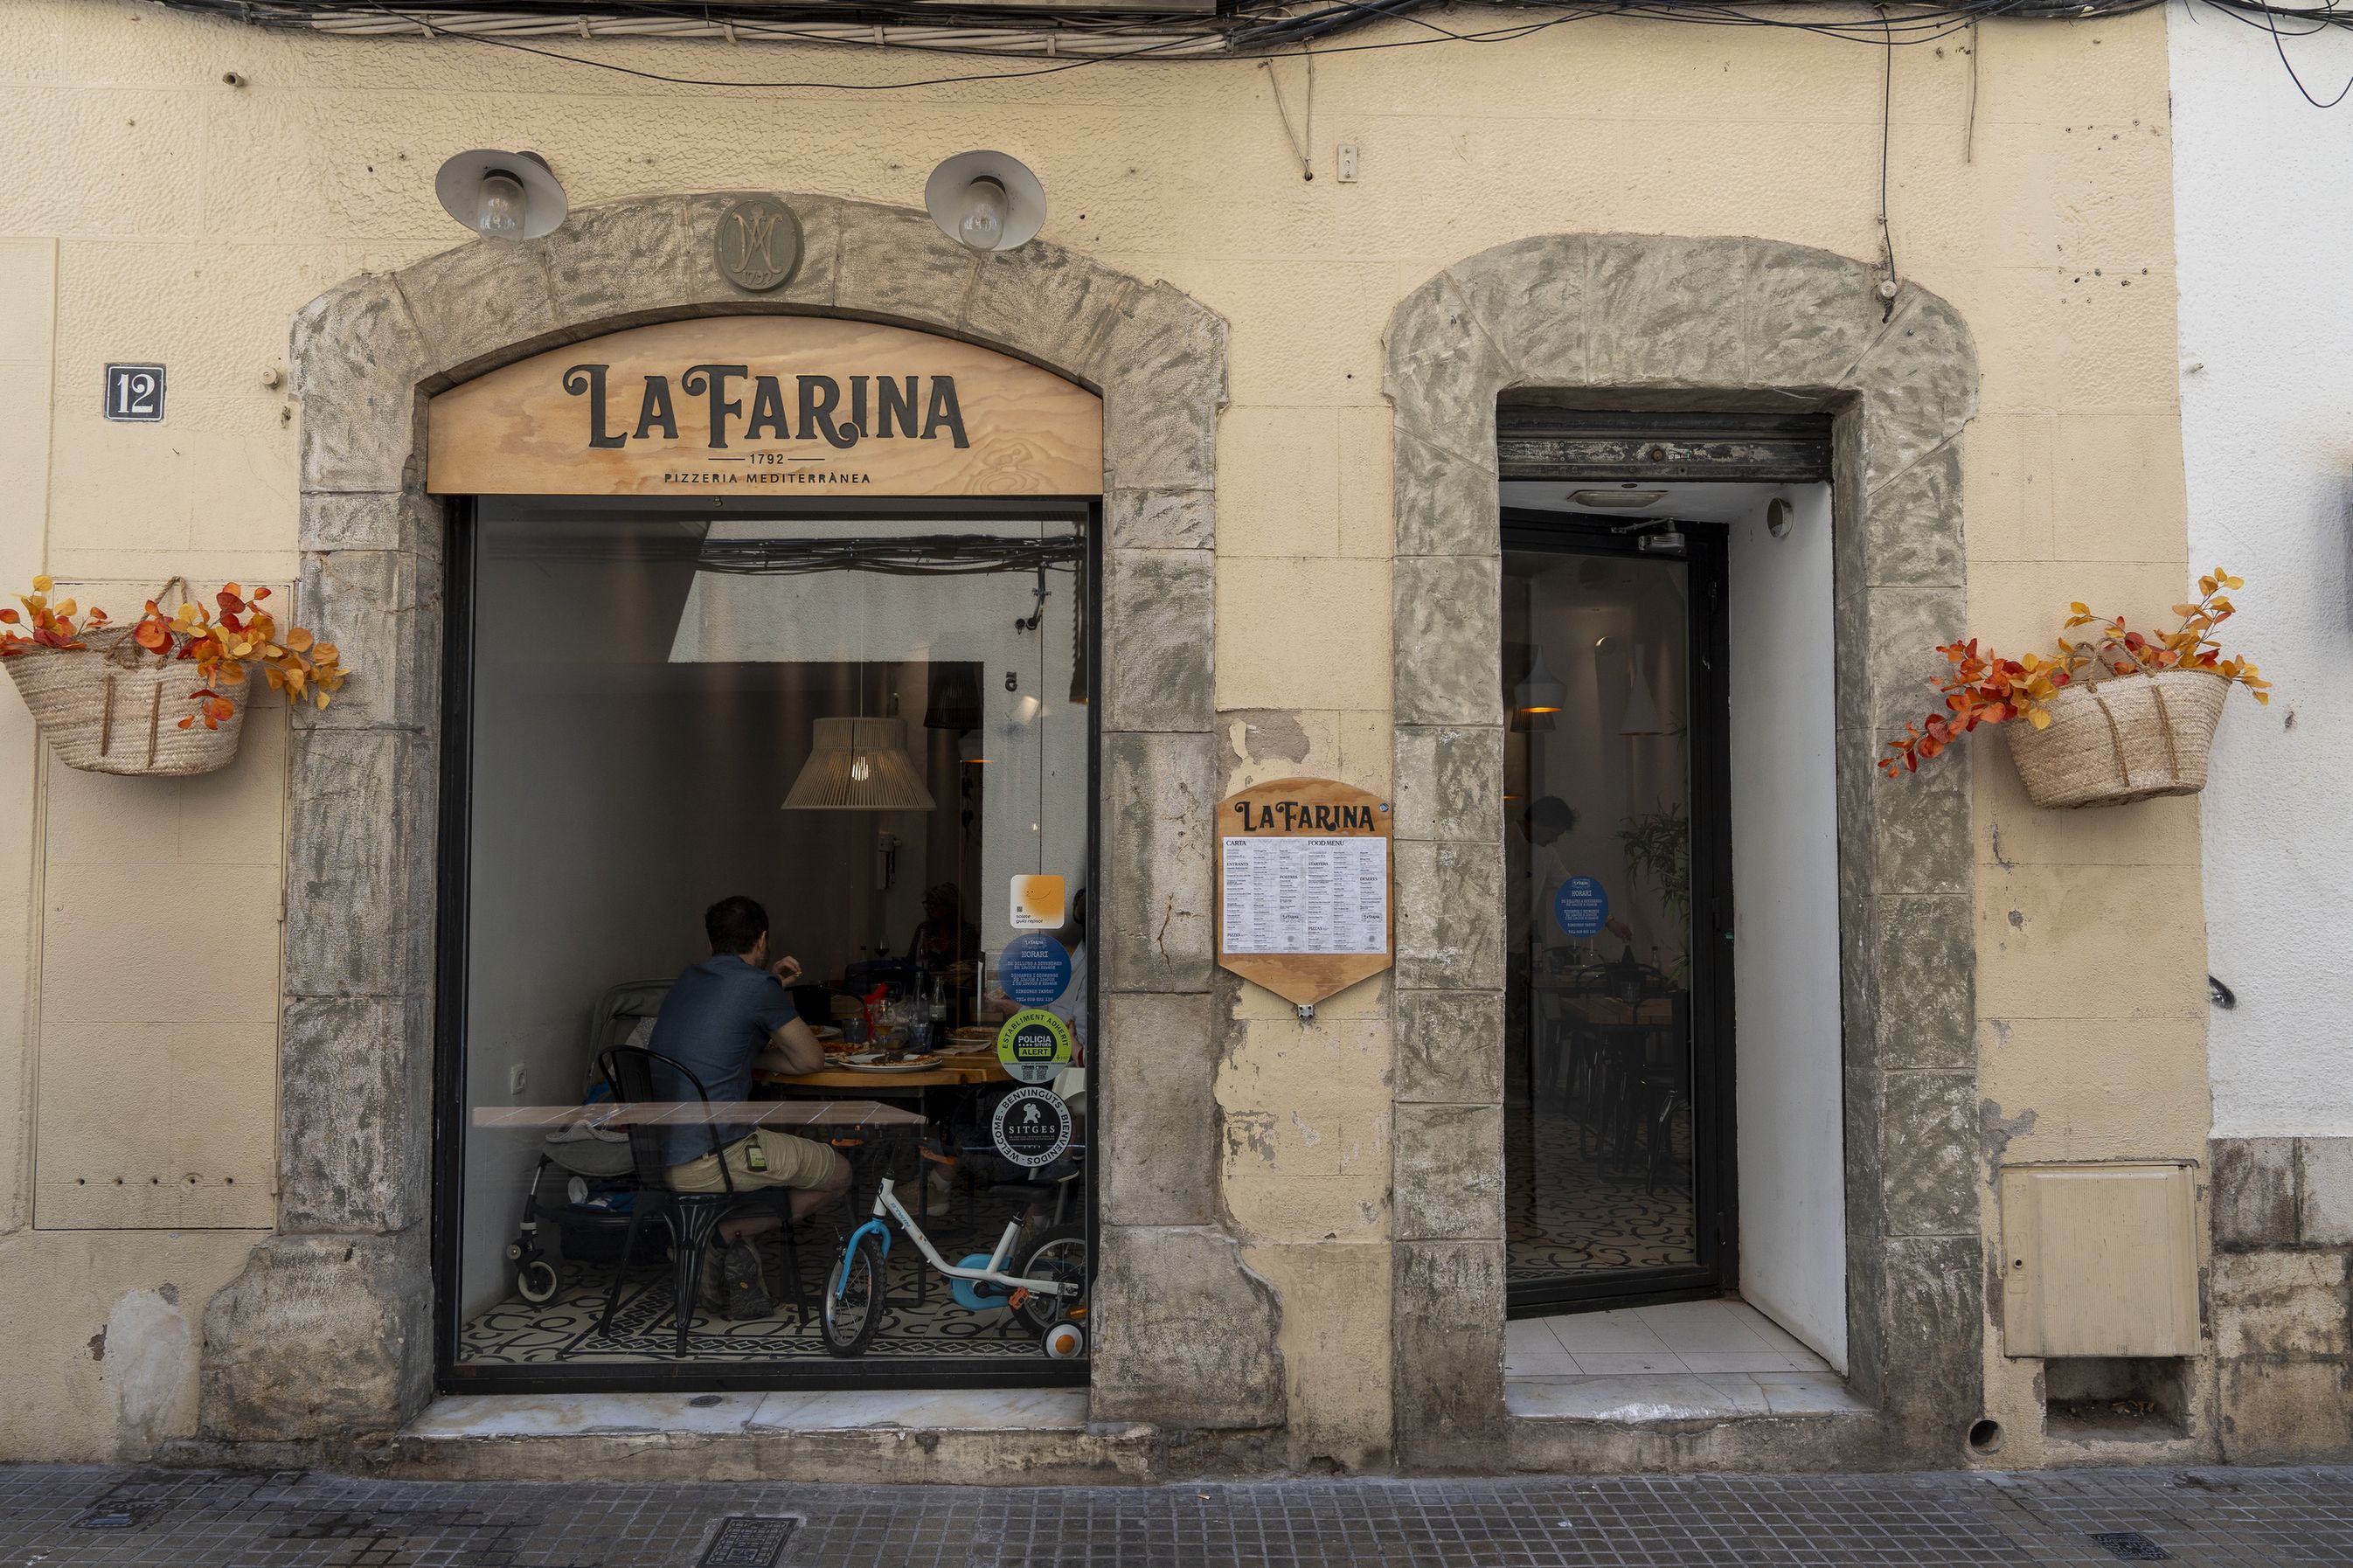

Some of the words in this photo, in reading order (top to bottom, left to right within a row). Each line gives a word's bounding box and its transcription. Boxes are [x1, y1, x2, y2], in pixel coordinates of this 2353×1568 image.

[116, 373, 155, 413] 12
[563, 364, 679, 448] LA
[682, 364, 970, 448] FARINA
[749, 454, 784, 465] 1792
[664, 474, 738, 483] PIZZERIA
[746, 472, 871, 483] MEDITERRÀNEA
[1235, 801, 1274, 831] LA
[1275, 801, 1375, 831] FARINA
[1002, 1014, 1045, 1049] ESTABLIMENT
[1046, 1017, 1069, 1046] ADHERIT
[1002, 1089, 1063, 1109] BENVINGUTS
[995, 1114, 1019, 1162] WELCOME
[1009, 1125, 1055, 1134] SITGES
[1027, 1114, 1070, 1165] BIENVENIDOS
